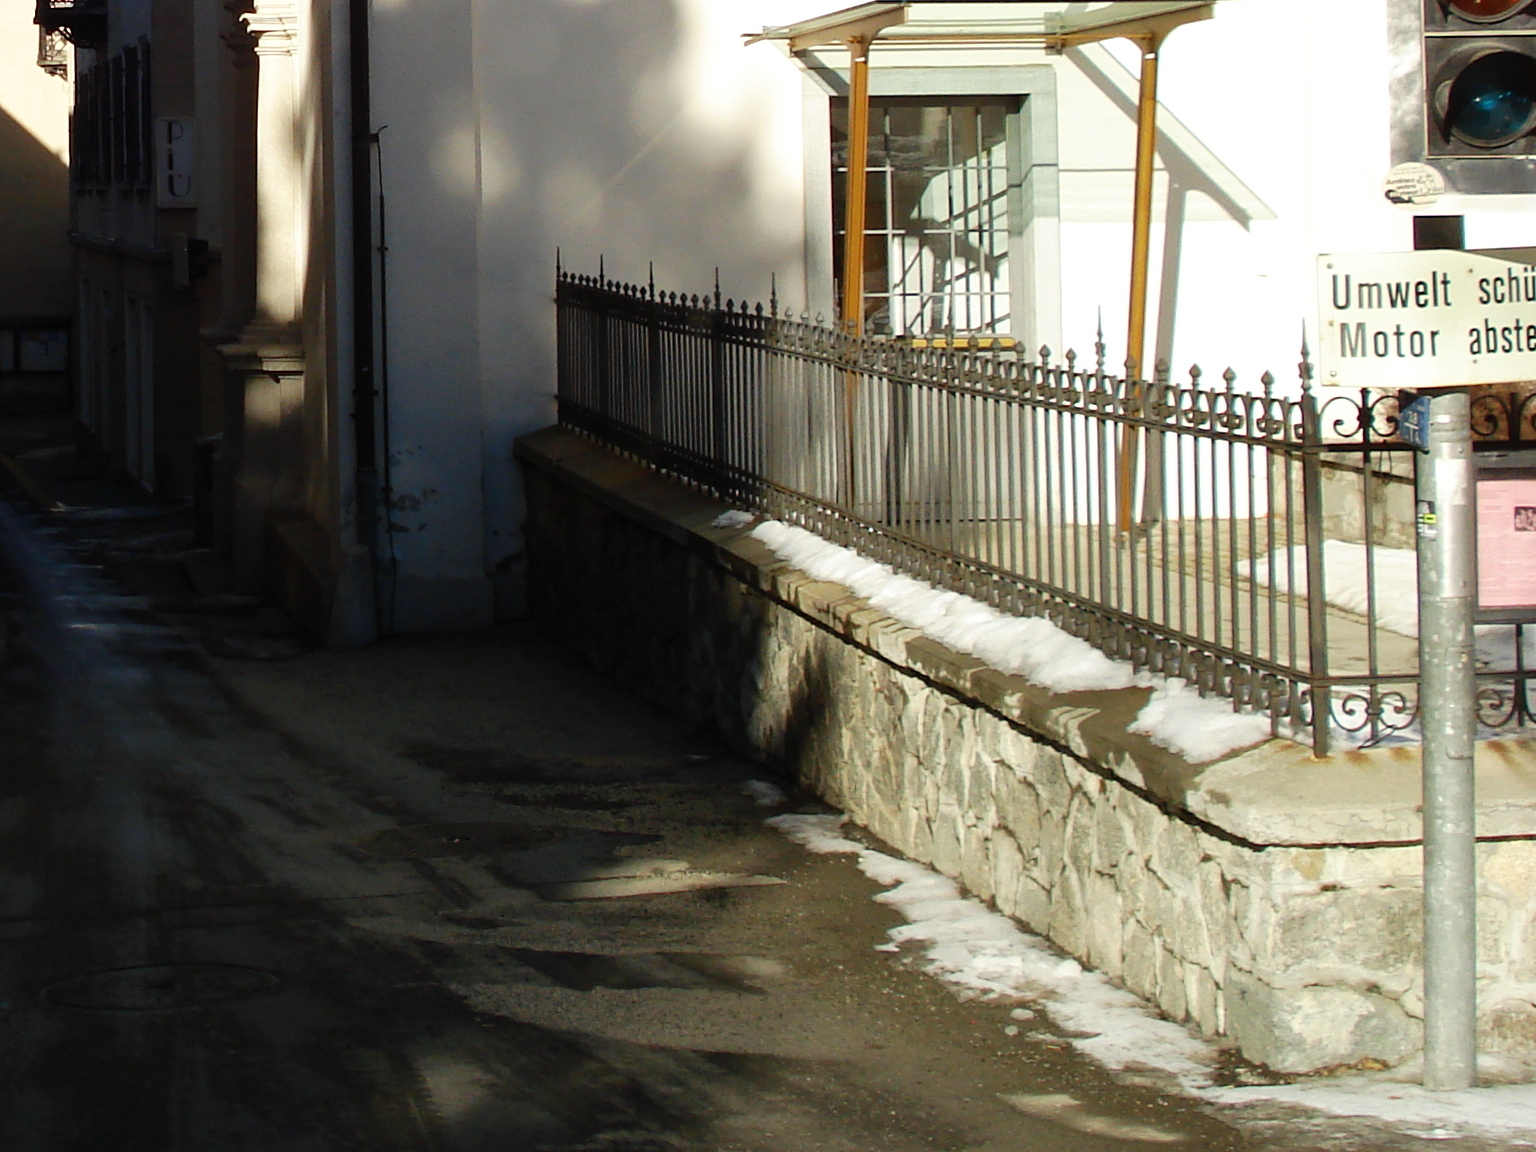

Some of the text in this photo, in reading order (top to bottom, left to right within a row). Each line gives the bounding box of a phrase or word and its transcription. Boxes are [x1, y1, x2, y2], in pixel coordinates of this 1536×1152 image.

[1332, 271, 1451, 310] Umwelt
[1340, 318, 1536, 358] Motor abste
